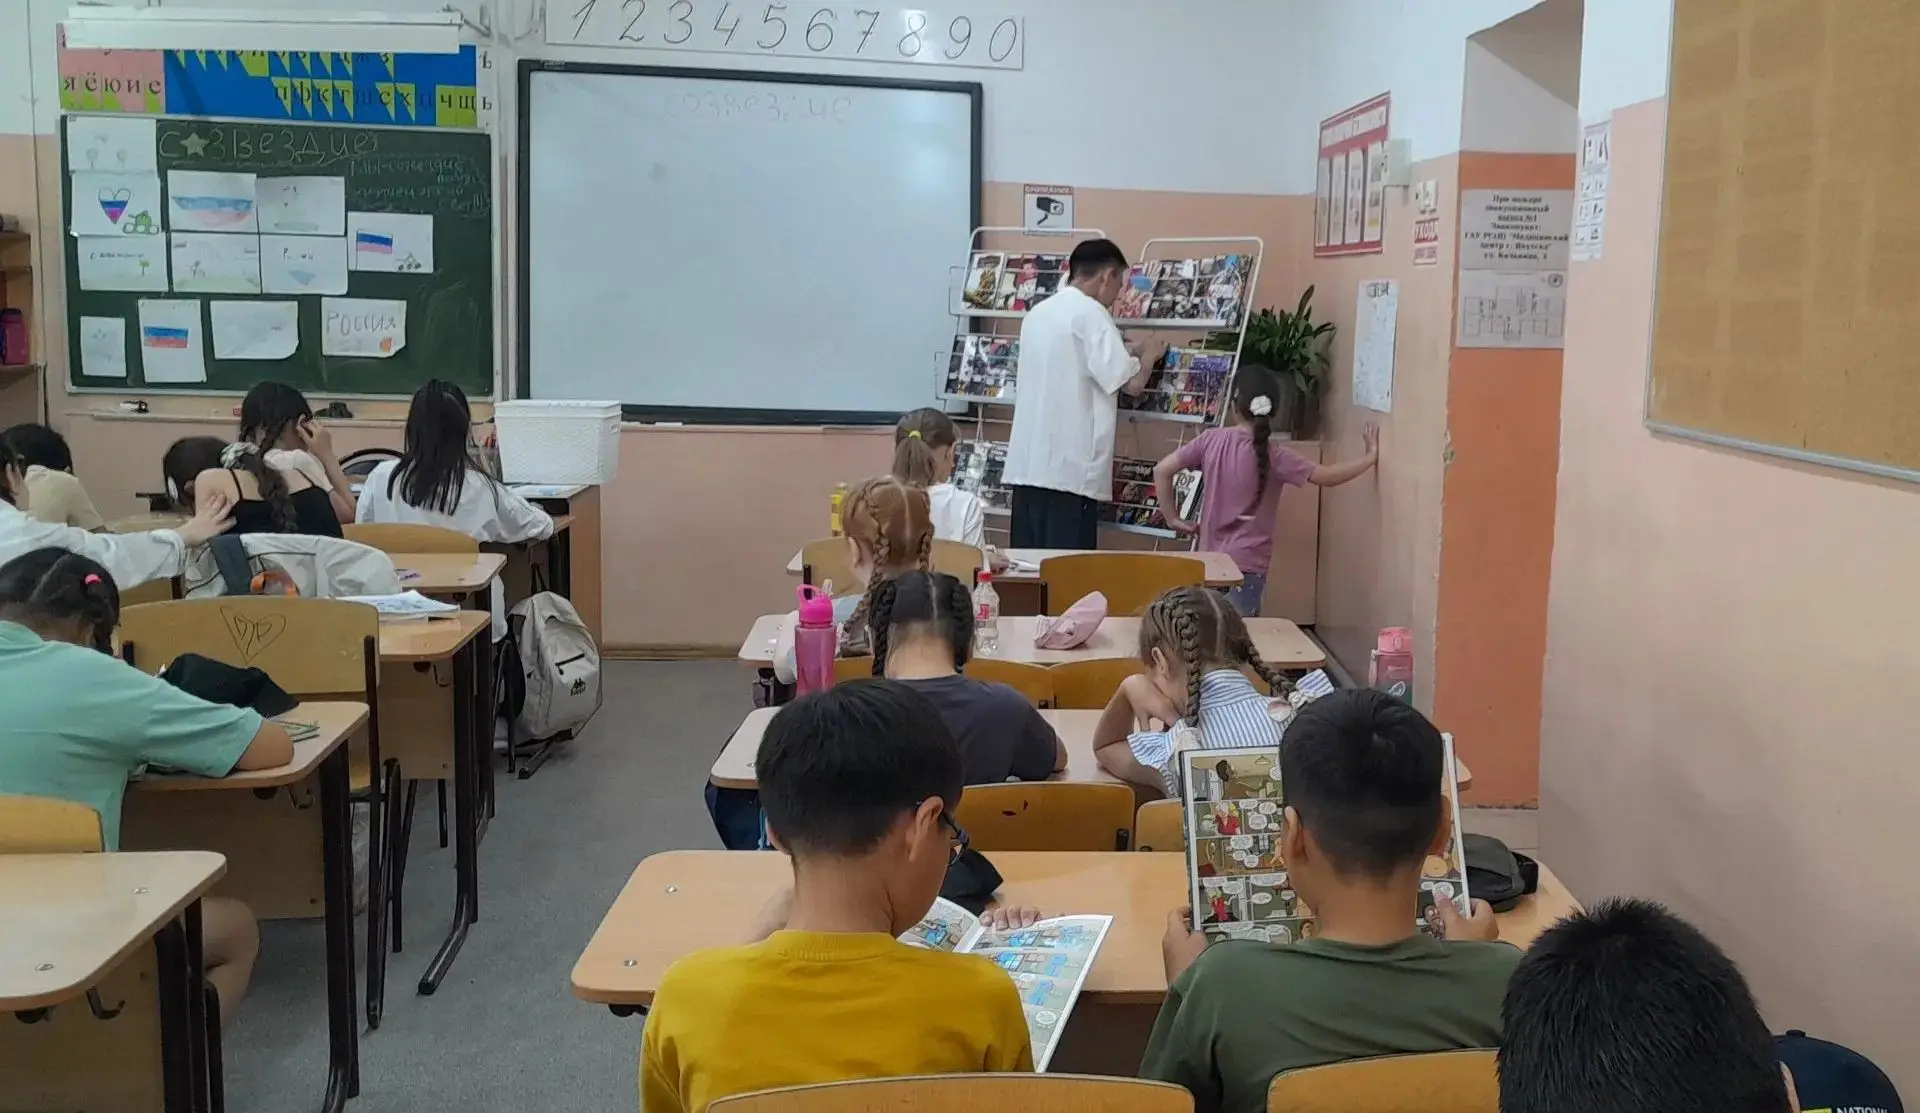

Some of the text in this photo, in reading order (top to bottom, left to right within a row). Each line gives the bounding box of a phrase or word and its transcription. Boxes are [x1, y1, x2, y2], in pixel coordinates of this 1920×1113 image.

[572, 0, 596, 40] 1
[618, 0, 645, 42] 2
[663, 0, 694, 44] 3
[713, 6, 742, 47] 4
[757, 5, 787, 49] 5
[805, 8, 836, 52] 6
[854, 10, 880, 54] 7
[899, 14, 926, 58] 8
[944, 16, 972, 60] 9
